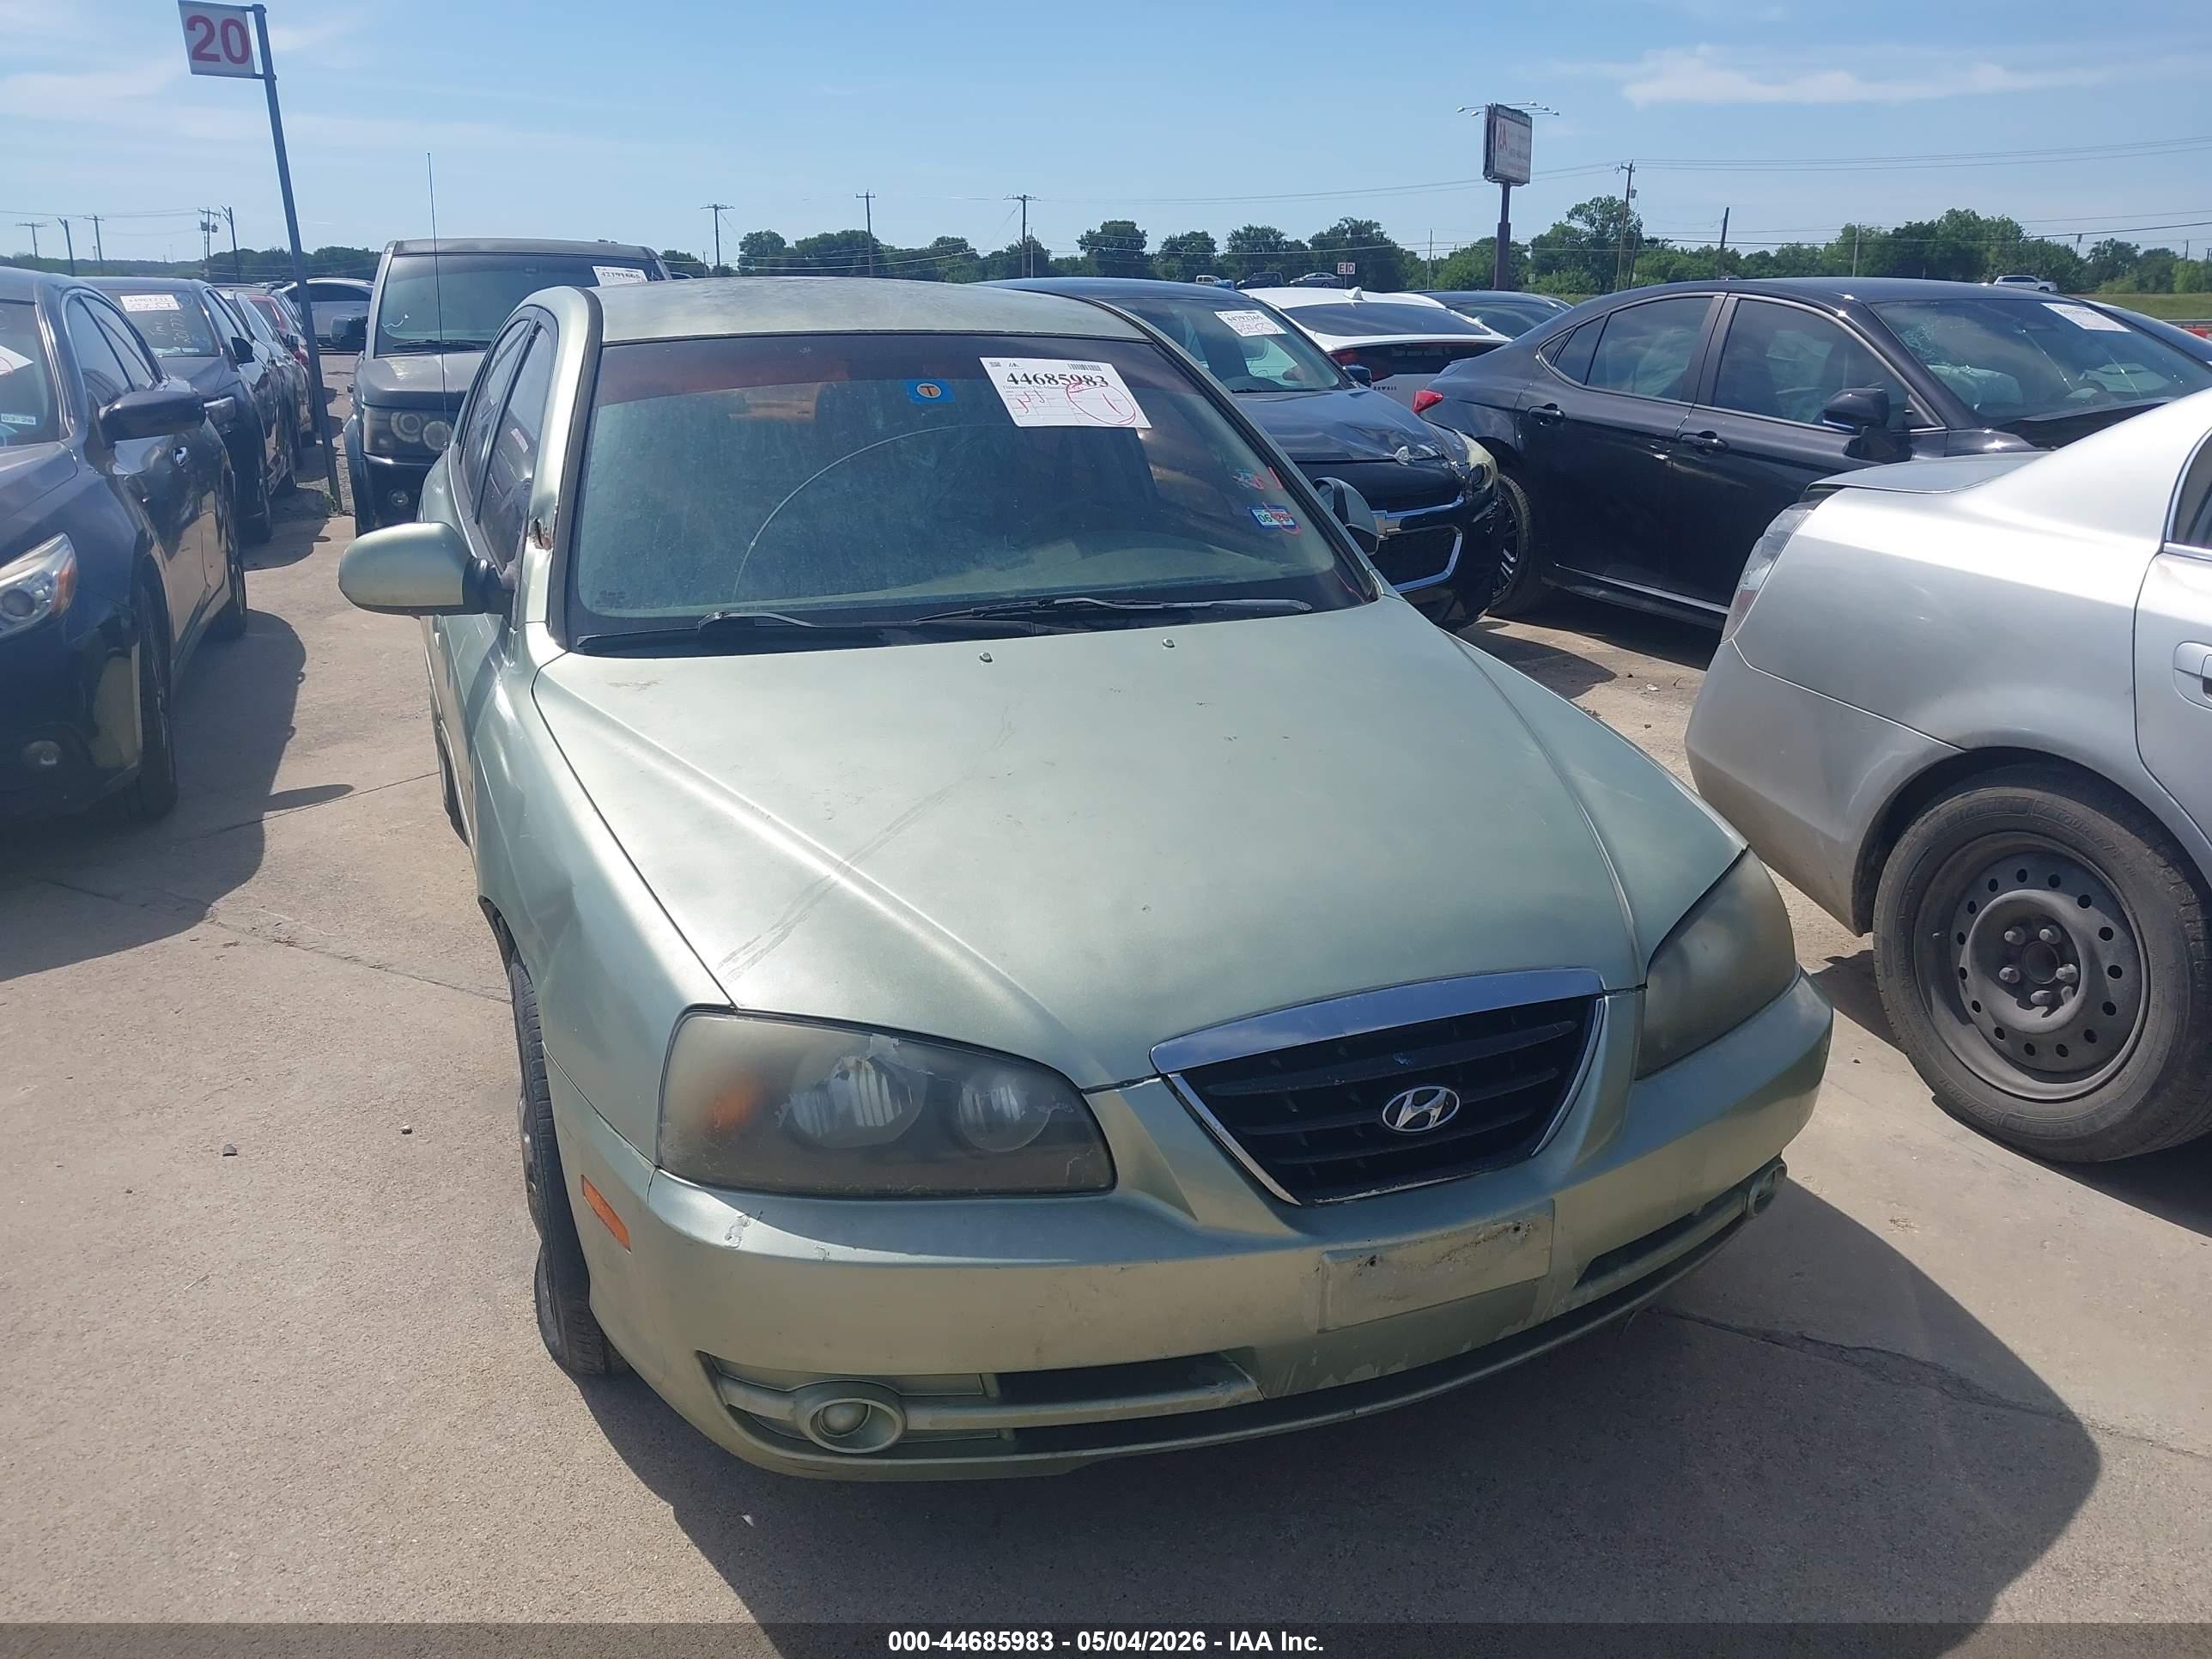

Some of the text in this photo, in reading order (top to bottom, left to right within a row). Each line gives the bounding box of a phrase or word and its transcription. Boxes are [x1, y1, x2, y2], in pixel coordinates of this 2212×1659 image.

[186, 15, 249, 64] 20
[1006, 373, 1109, 387] 44685983
[1258, 514, 1273, 523] 06
